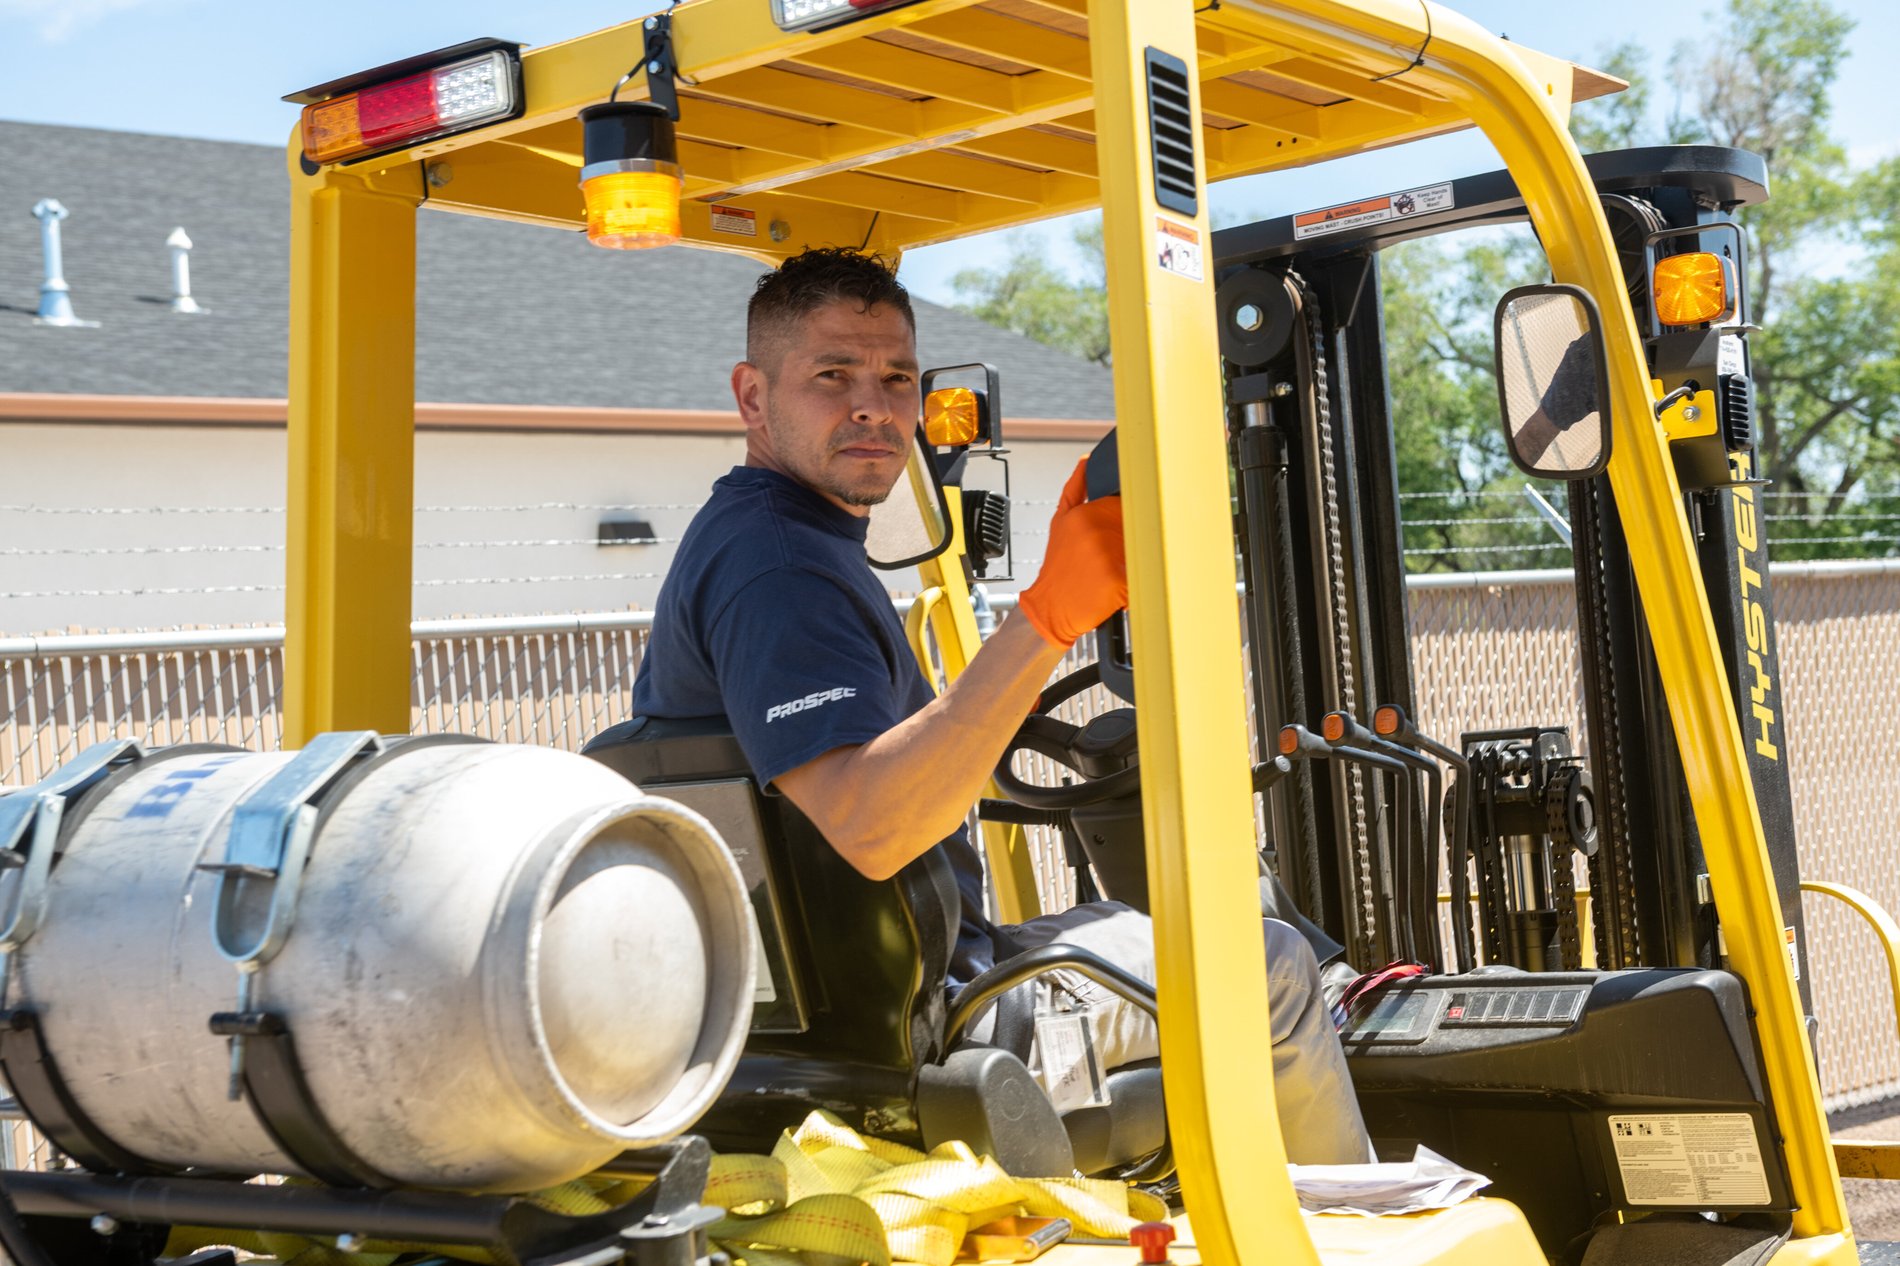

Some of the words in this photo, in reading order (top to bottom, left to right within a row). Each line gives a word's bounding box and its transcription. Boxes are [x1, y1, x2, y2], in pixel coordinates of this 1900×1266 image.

[1304, 225, 1325, 233] MOVING
[1325, 220, 1340, 229] MAST
[1344, 217, 1362, 225] CRUSH
[1335, 207, 1361, 217] WARNING
[1728, 451, 1778, 761] HYSTER
[766, 687, 857, 723] PROSPEC
